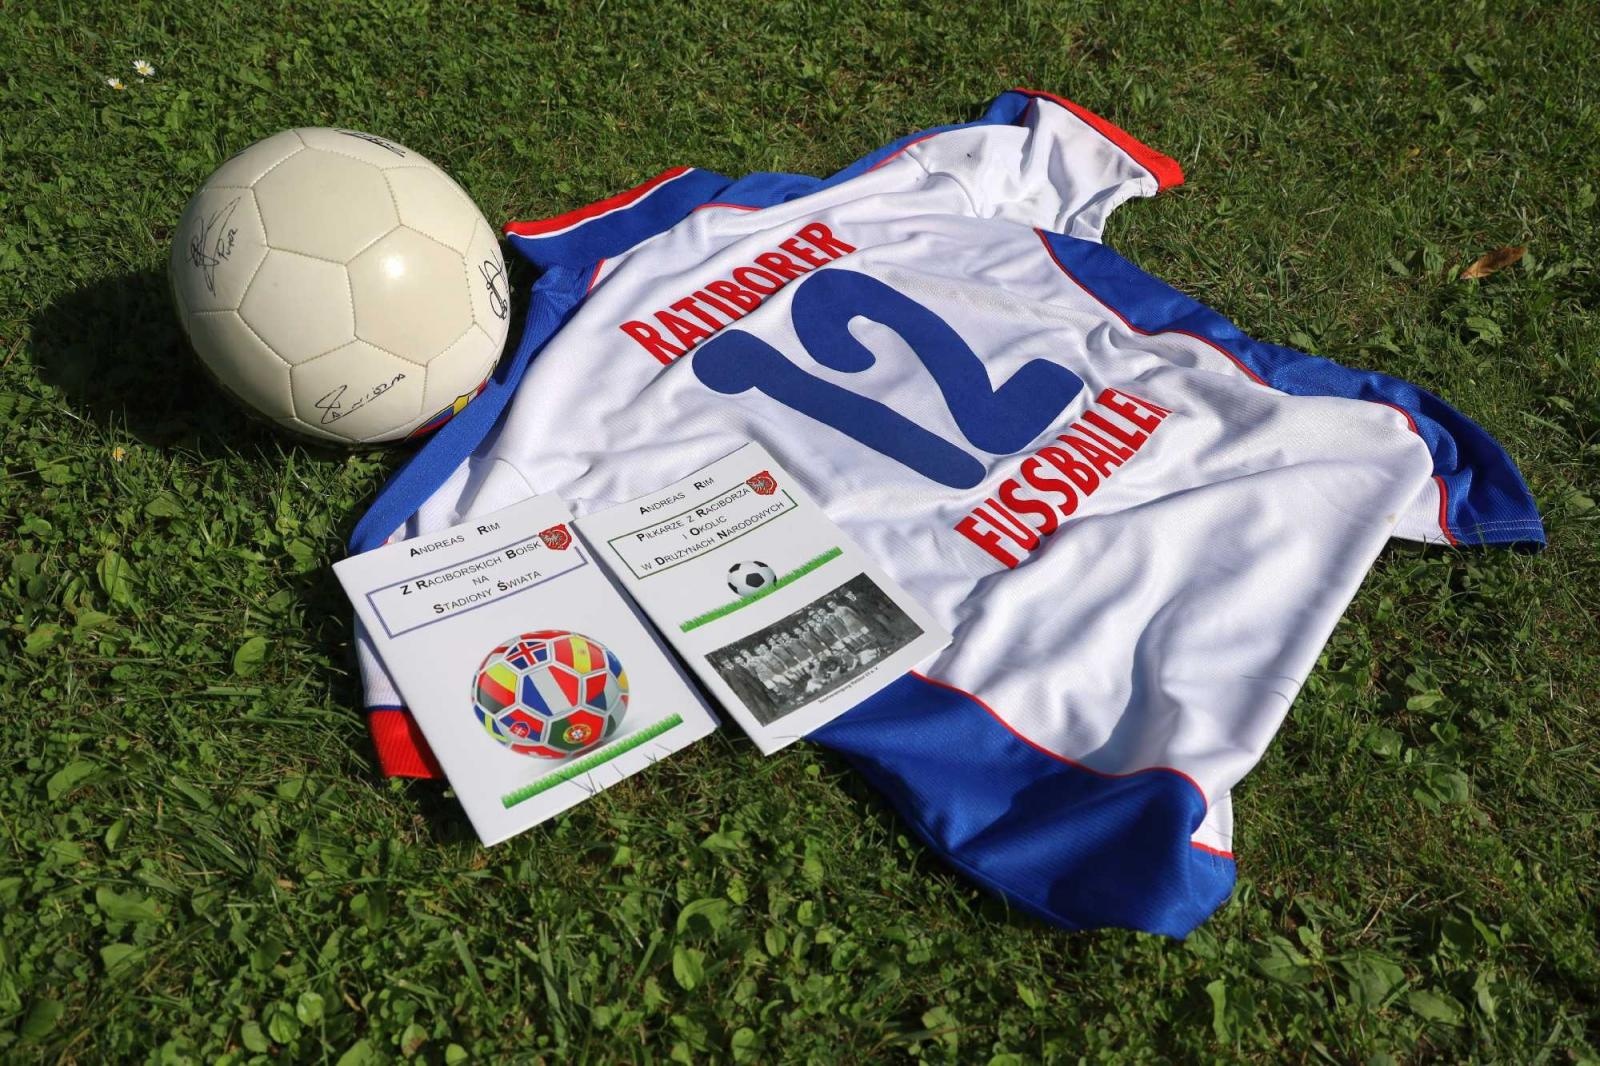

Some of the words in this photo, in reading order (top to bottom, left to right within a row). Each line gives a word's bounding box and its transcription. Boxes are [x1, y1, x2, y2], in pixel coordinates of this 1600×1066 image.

[620, 222, 857, 366] RATIBORER
[692, 268, 1084, 489] 12
[640, 492, 686, 515] ANDREAS
[693, 477, 714, 491] RIM
[695, 488, 751, 518] RACIBORZA
[689, 515, 728, 536] OKOLIC
[716, 501, 785, 540] NARODOWYCH
[409, 535, 465, 558] ANDREAS
[476, 522, 501, 536] RIM
[400, 584, 413, 596] Z
[415, 557, 502, 590] RACIBORSKICH
[505, 540, 542, 560] BOISK
[471, 575, 490, 586] NA
[433, 588, 493, 614] STADIONY
